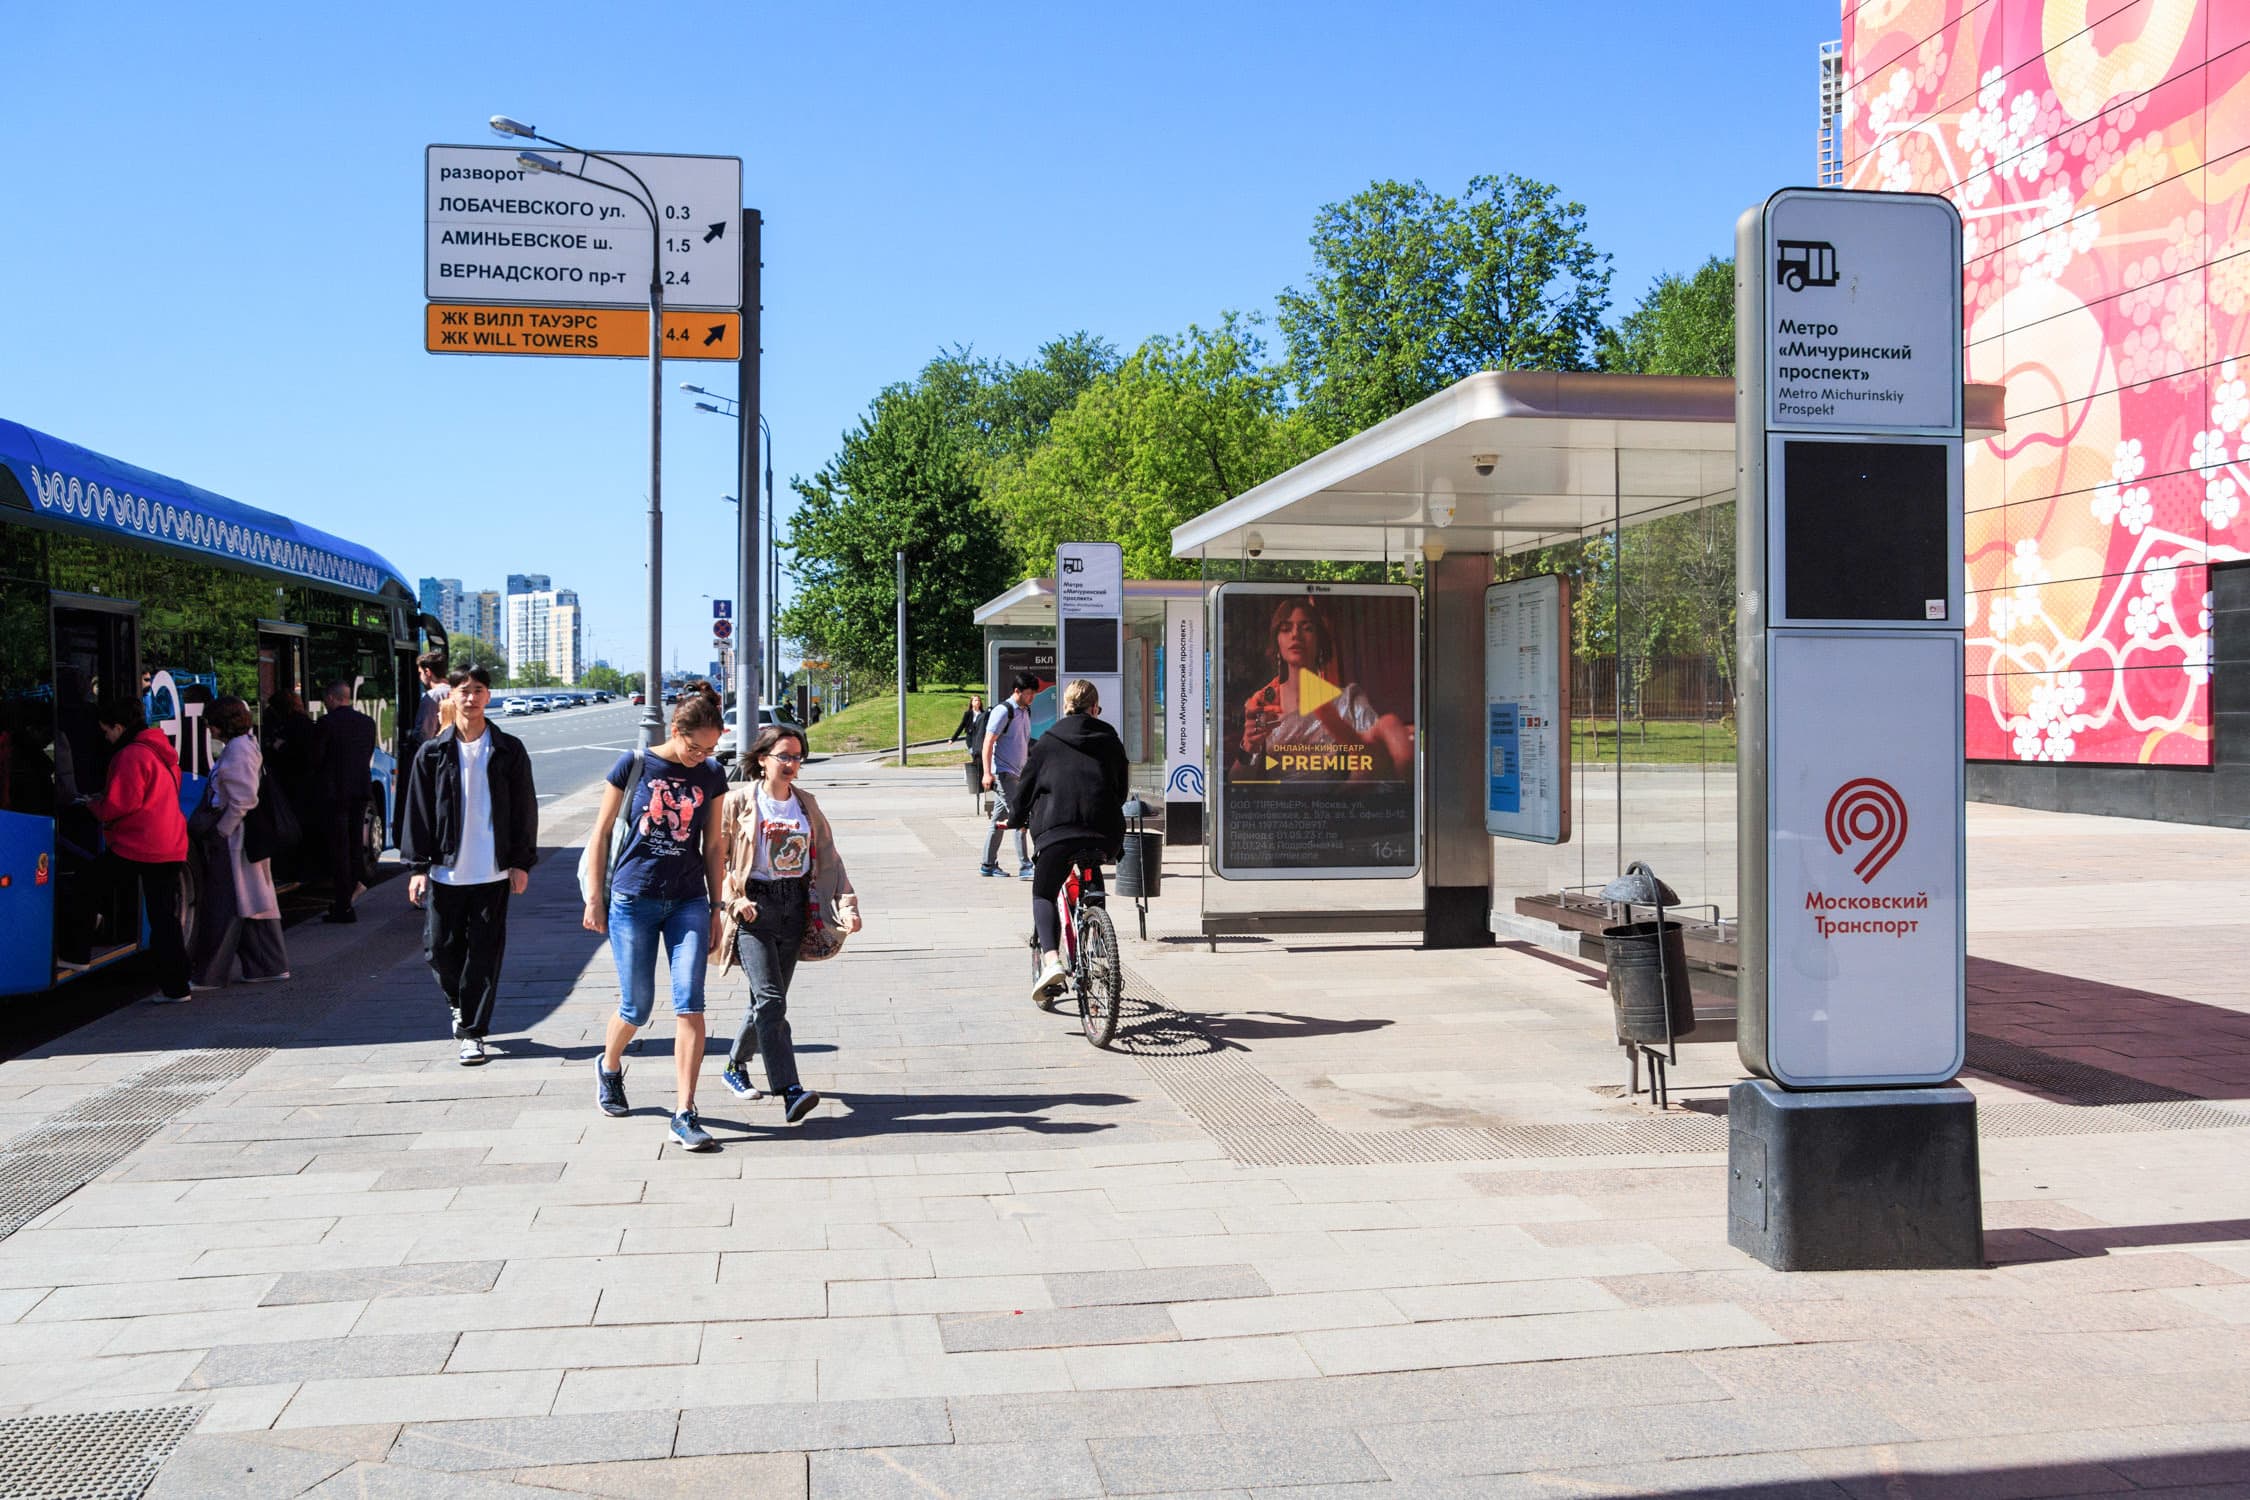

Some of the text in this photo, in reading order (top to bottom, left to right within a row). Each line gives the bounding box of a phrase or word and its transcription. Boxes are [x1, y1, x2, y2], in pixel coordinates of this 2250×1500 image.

[440, 165, 526, 183] разворот
[439, 197, 691, 220] ЛОБАЧЕВСКОГО ул. 0.3
[441, 230, 691, 253] АМИНЬЕВСКОЕ ш. 1.5
[440, 263, 691, 285] ВЕРНАДСКОГО пр-т 2.4
[441, 311, 598, 329] ЖК ВИЛЛ ТАУЭРС
[1778, 318, 1838, 338] Метро
[441, 328, 690, 348] ЖК WILL TOWERS 4.4
[1779, 341, 1912, 361] «Мичуринский
[1779, 366, 1870, 381] проспект»
[1778, 387, 1904, 404] Metro Michurinskiy
[1779, 403, 1835, 417] Prospekt
[1035, 656, 1054, 664] БКЛ
[1178, 619, 1187, 755] Метро «Мичуринский проспект»
[1273, 743, 1365, 752] ОНЛАЙН-КИНОТЕАТР
[1281, 755, 1373, 771] PREMIER
[1371, 839, 1407, 858] 16+
[1805, 891, 1928, 909] Московский
[1814, 915, 1919, 939] Транспорт
